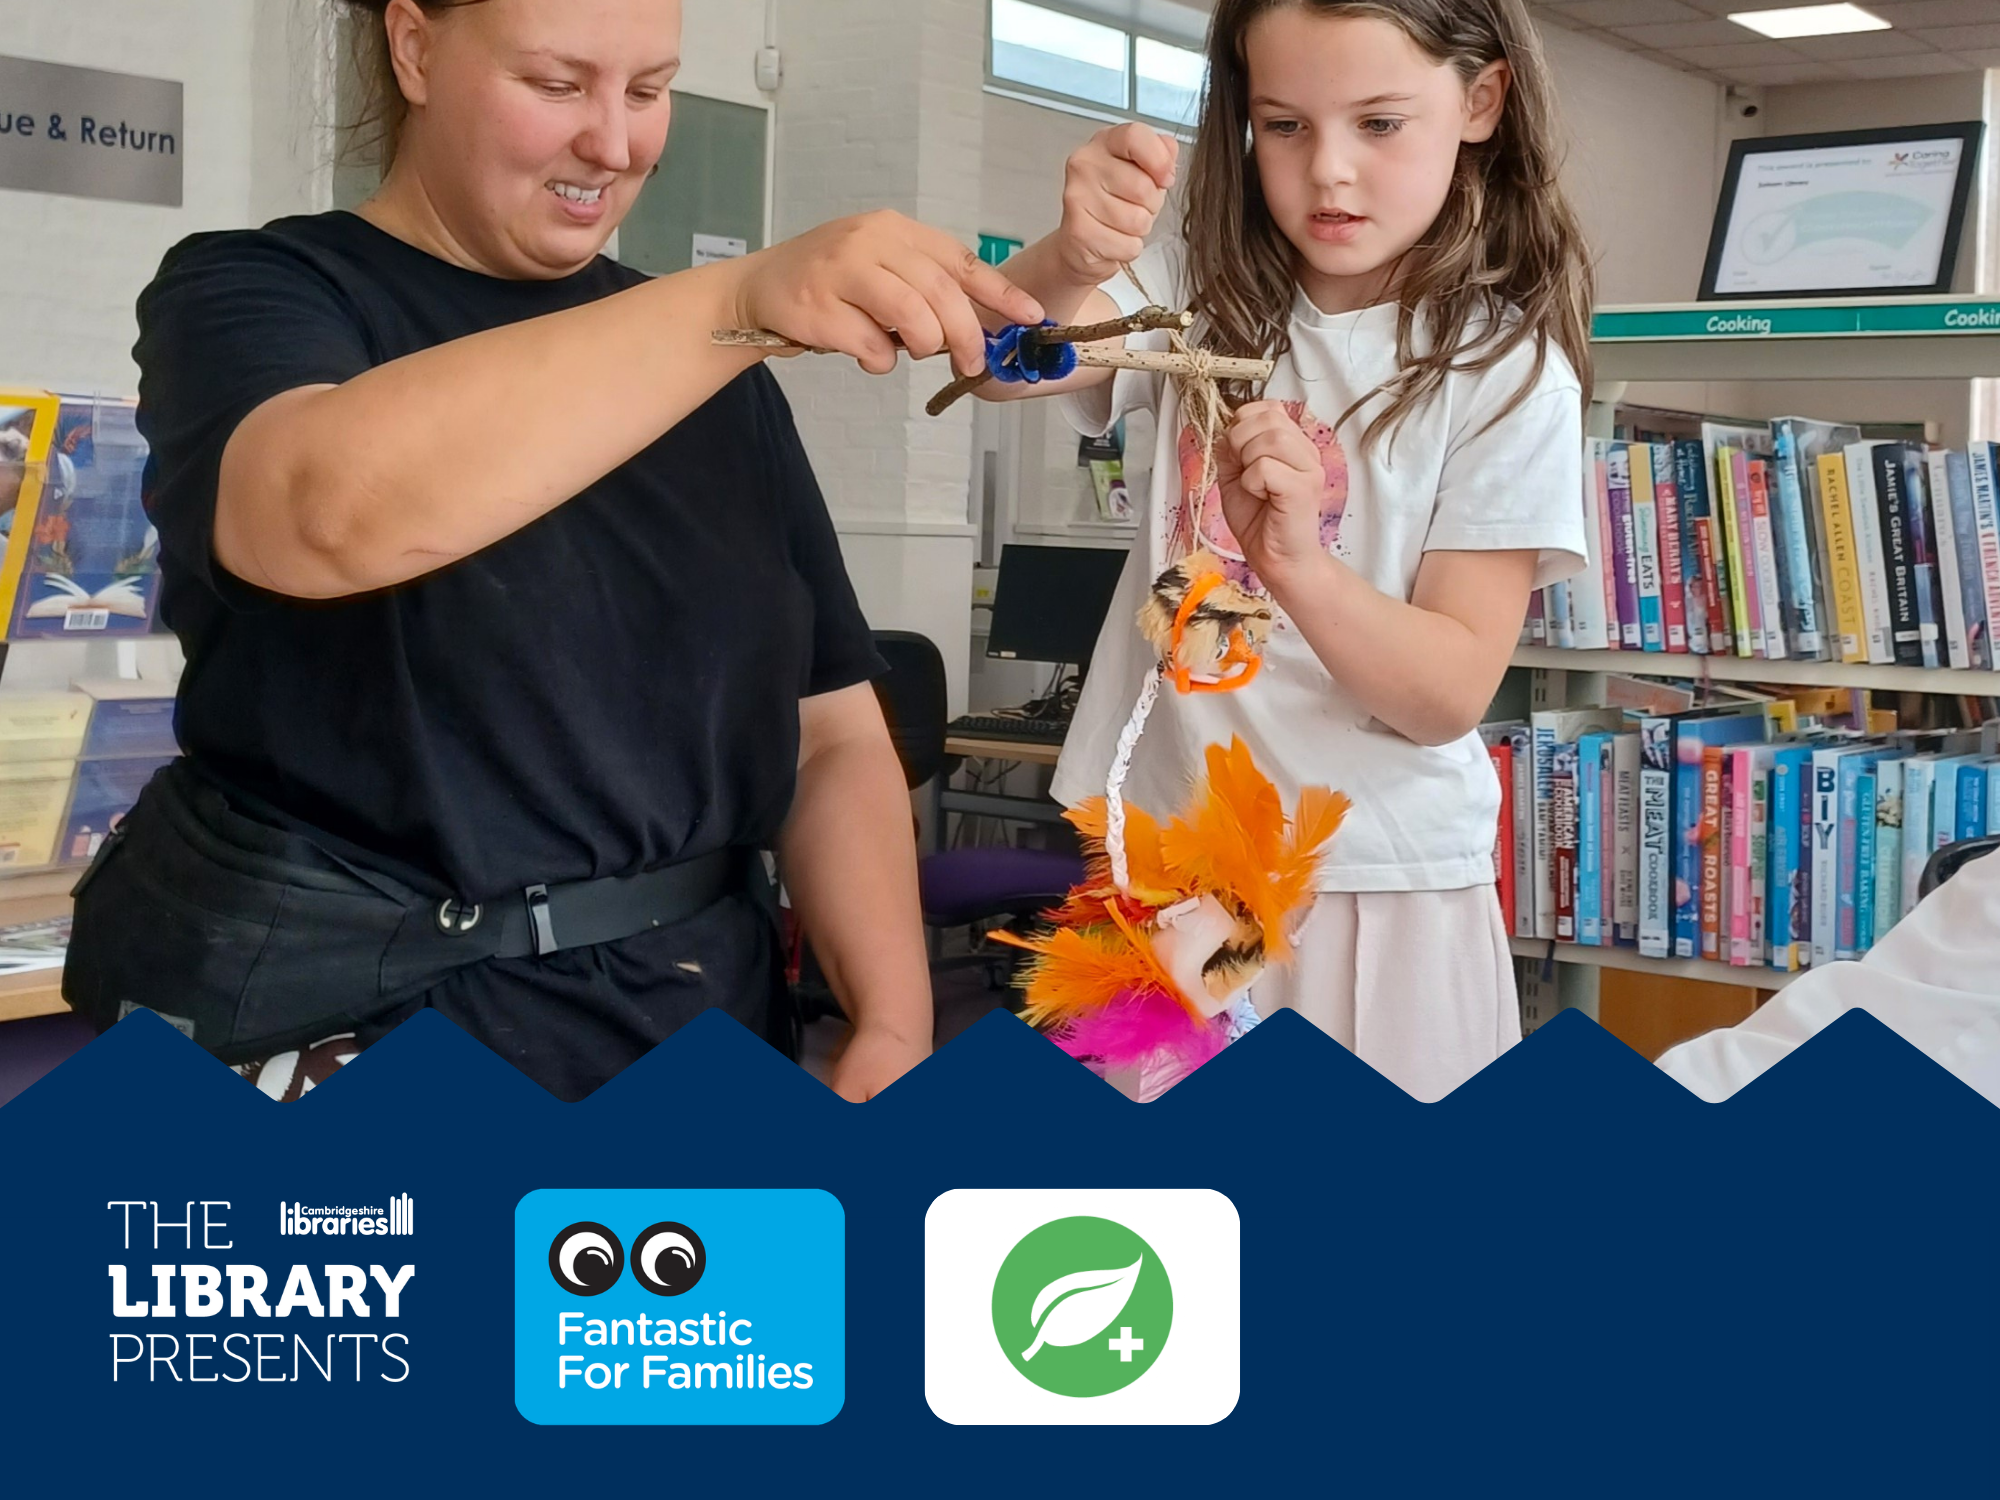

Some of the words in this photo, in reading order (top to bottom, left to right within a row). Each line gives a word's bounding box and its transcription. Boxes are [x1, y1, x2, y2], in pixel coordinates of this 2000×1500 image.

[47, 113, 67, 141] &
[81, 115, 175, 154] Return
[1706, 315, 1771, 335] Cooking
[1827, 468, 1842, 520] RACHEL
[1884, 459, 1897, 513] JAMIE'S
[1973, 453, 1989, 483] JAMES
[1611, 490, 1624, 555] cookbook
[1664, 495, 1678, 532] MARY
[1977, 483, 1994, 530] MARTIN'S
[1622, 514, 1637, 584] gluten-free
[1833, 522, 1846, 562] ALLEN
[1890, 513, 1904, 563] GREAT
[1641, 554, 1655, 590] EATS
[1837, 567, 1855, 625] COAST
[1894, 566, 1910, 623] BRITAIN
[1988, 586, 2000, 641] ADVENTUR
[1536, 728, 1555, 800] JERUSALEM
[1618, 770, 1630, 795] MEAT
[1563, 787, 1575, 849] AMERICAN
[1618, 796, 1631, 832] FEASTS
[1644, 787, 1667, 855] MEAT
[1705, 770, 1719, 827] GREAT
[1648, 854, 1659, 920] COOKBOOK
[1704, 855, 1718, 923] ROASTS
